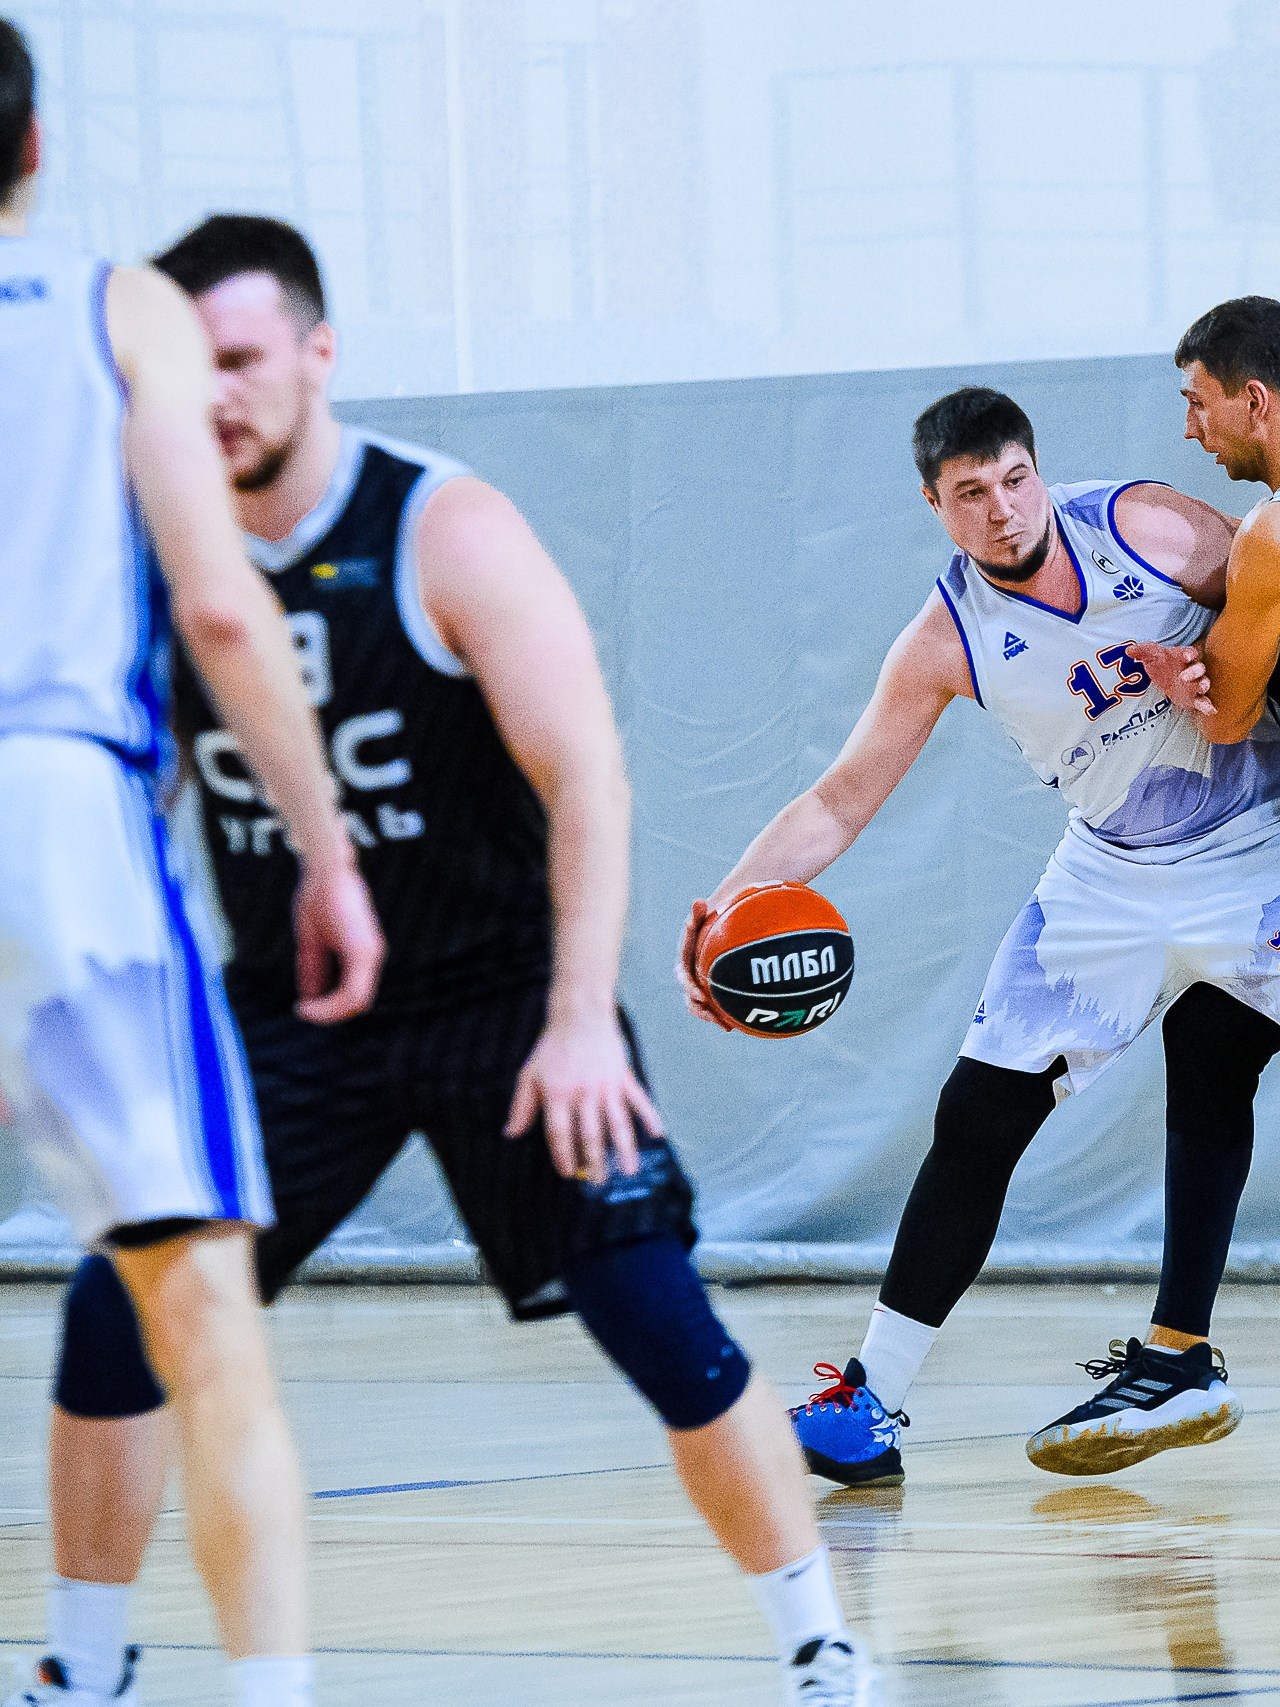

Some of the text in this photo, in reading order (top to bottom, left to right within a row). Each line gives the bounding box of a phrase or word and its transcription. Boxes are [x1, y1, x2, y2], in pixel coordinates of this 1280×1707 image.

[1002, 640, 1030, 661] PEAK
[1066, 639, 1153, 722] 13
[194, 708, 413, 804] СС
[218, 802, 426, 857] УГЬ
[750, 945, 836, 985] МЛБЛ
